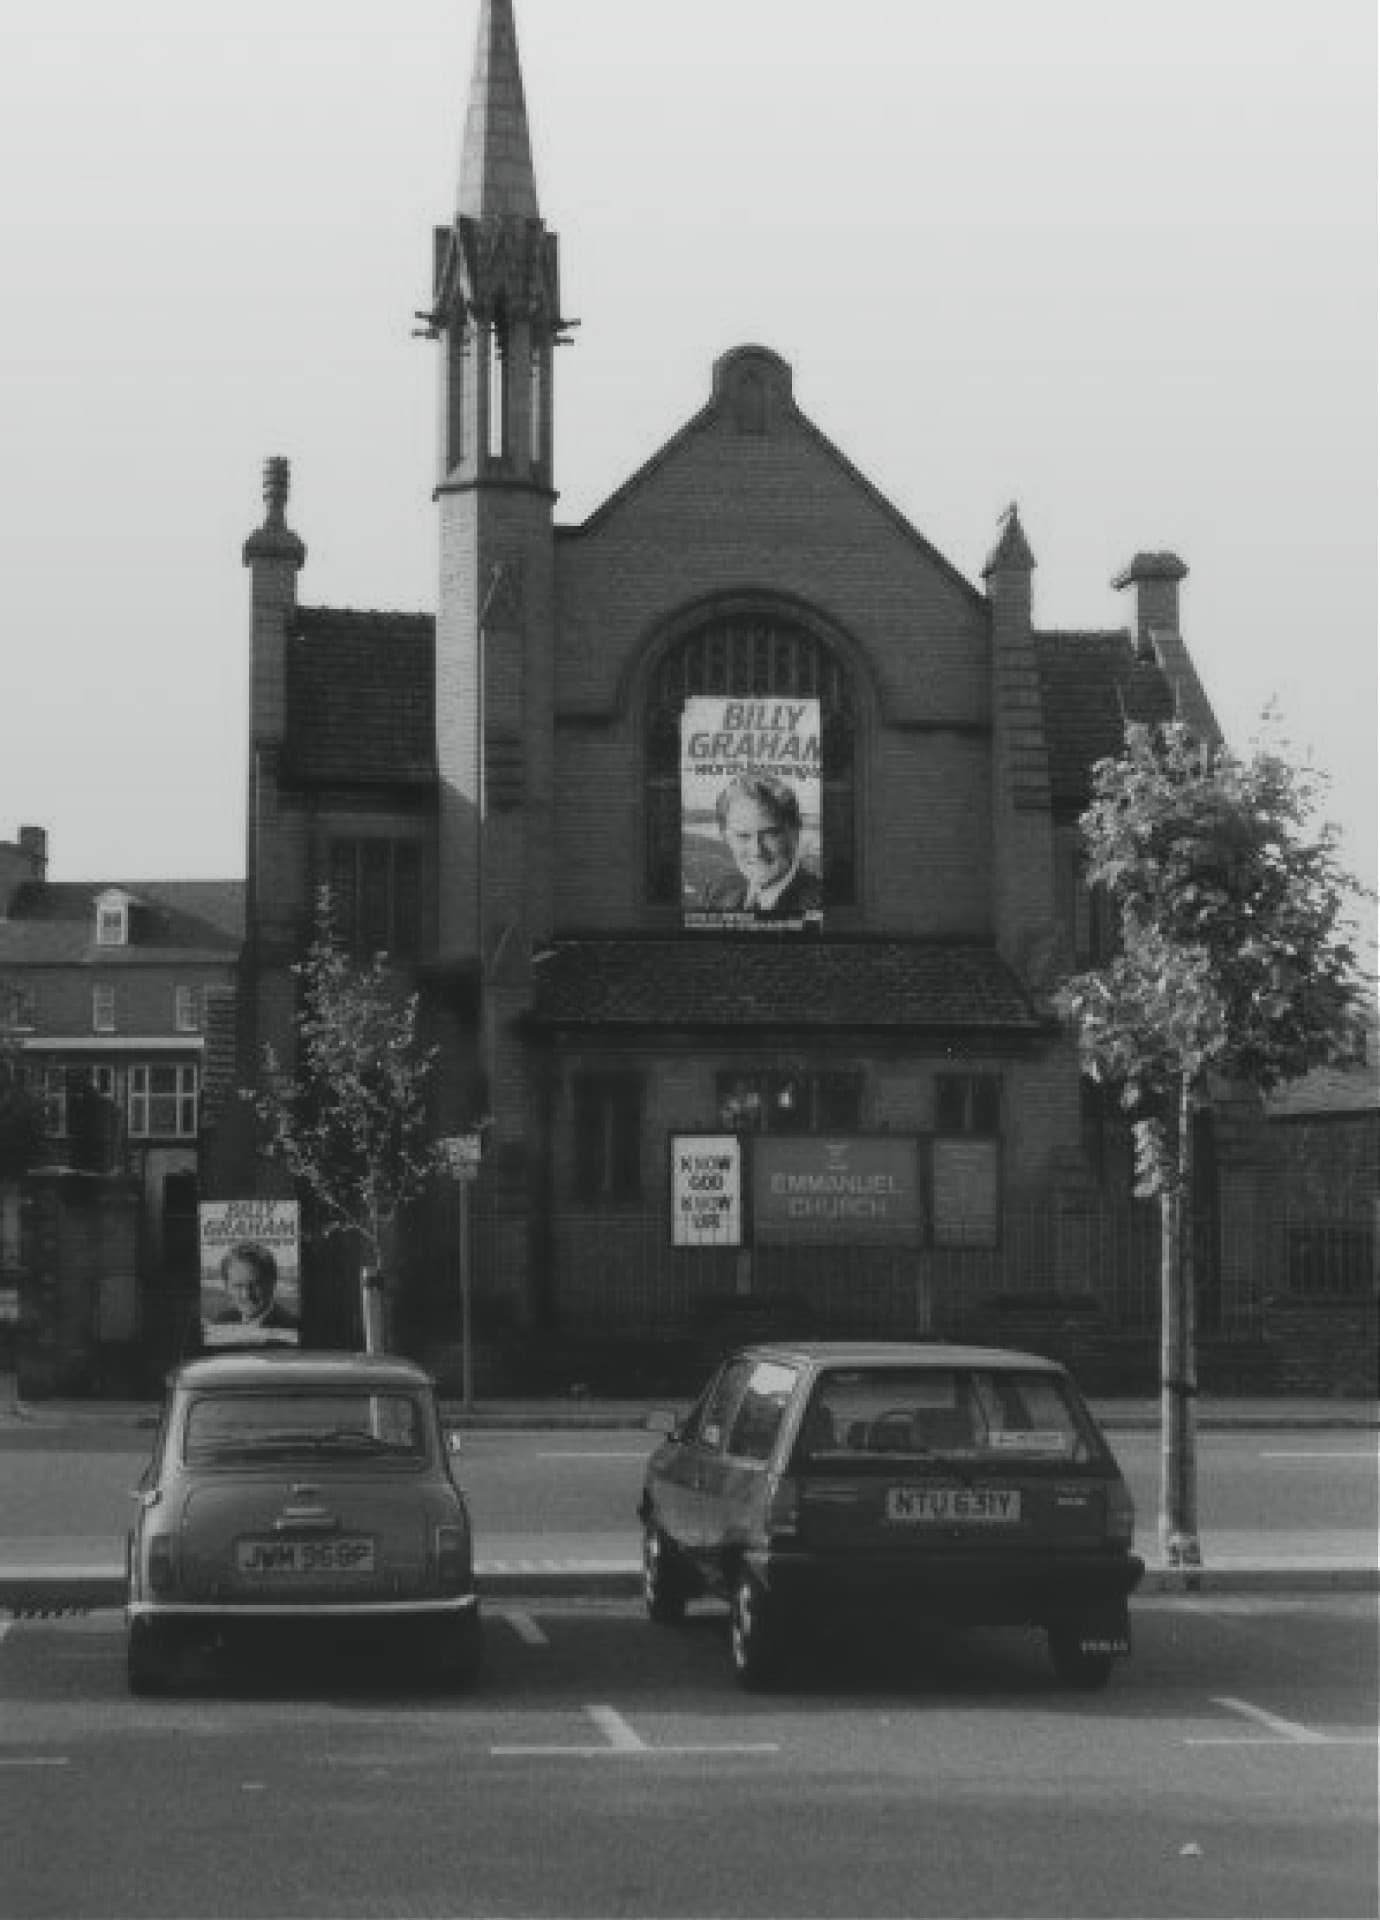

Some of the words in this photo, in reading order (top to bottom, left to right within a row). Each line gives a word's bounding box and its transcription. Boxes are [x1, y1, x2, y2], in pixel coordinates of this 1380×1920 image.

[723, 702, 806, 730] BILLY
[681, 1155, 733, 1172] KNOW
[688, 1175, 724, 1190] GOD
[771, 1173, 899, 1195] EMMANUEL
[681, 1194, 733, 1211] KNOW
[788, 1197, 888, 1219] CHURCH
[204, 1218, 295, 1235] GRAHAM
